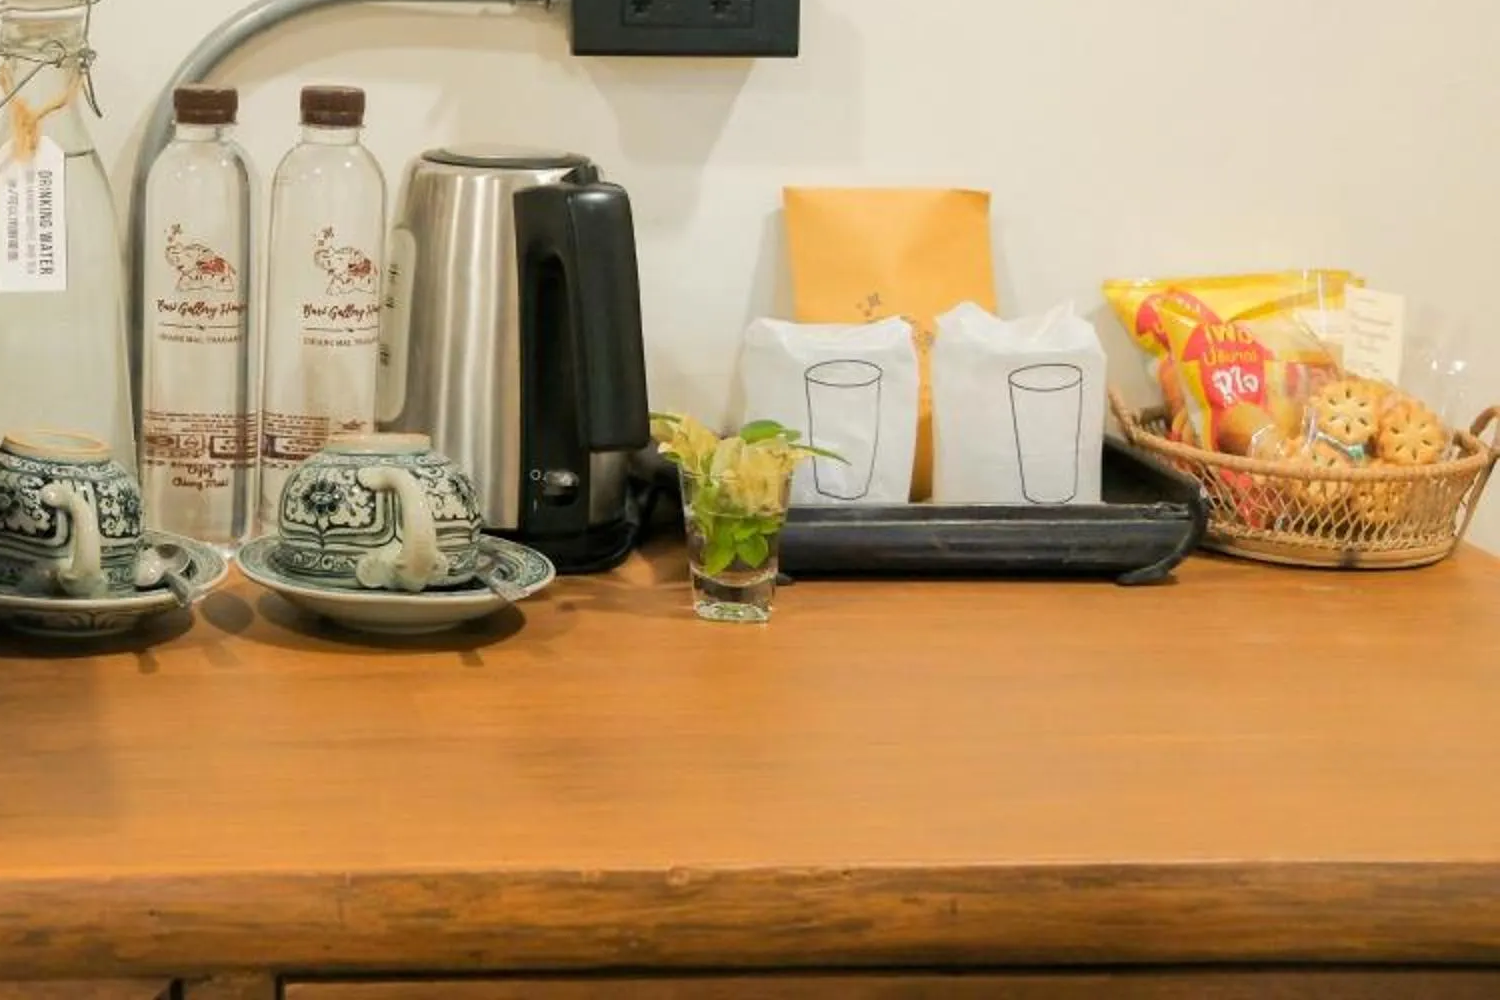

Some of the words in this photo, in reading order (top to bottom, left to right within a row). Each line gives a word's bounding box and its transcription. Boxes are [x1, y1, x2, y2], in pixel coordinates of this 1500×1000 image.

[38, 169, 53, 229] DRINKING
[39, 232, 54, 275] WATER
[178, 300, 217, 320] Gallery
[328, 304, 365, 322] Gallery
